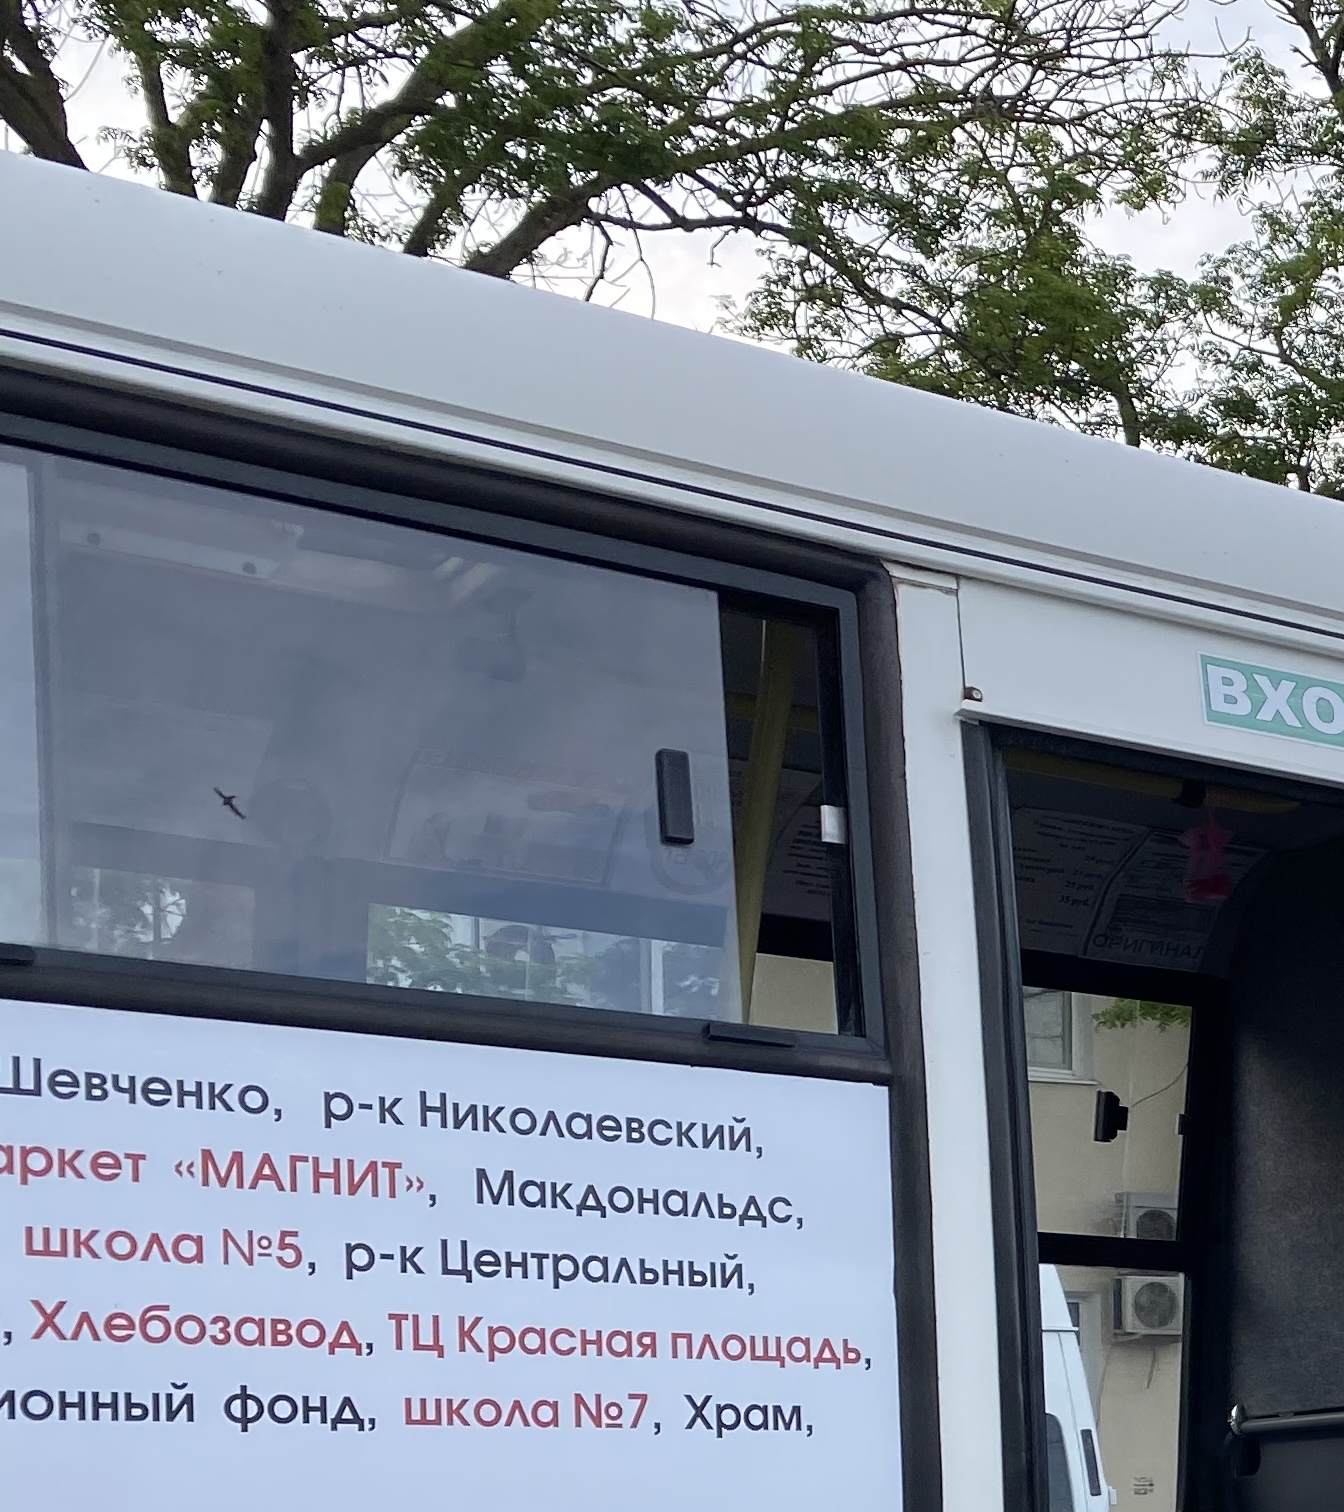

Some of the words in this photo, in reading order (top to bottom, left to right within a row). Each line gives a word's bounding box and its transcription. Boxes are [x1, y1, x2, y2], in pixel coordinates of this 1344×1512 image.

[0, 1055, 283, 1122] Шевченко,
[323, 1090, 404, 1129] р-к
[418, 1089, 764, 1159] Николаевский,
[174, 1147, 437, 1208] «МАГНИТ»,
[475, 1167, 803, 1230] Макдональдс,
[24, 1225, 204, 1264] школа
[222, 1228, 317, 1277] №5,
[345, 1241, 425, 1280] р-к
[440, 1238, 756, 1296] Центральный,
[30, 1299, 374, 1356] Хлебозавод,
[388, 1312, 445, 1359] ТЦ
[457, 1315, 658, 1362] Красная
[670, 1331, 872, 1371] площадь,
[223, 1385, 377, 1433] фонд,
[404, 1396, 560, 1428] школа
[573, 1393, 662, 1436] №7,
[683, 1393, 814, 1439] Храм,
